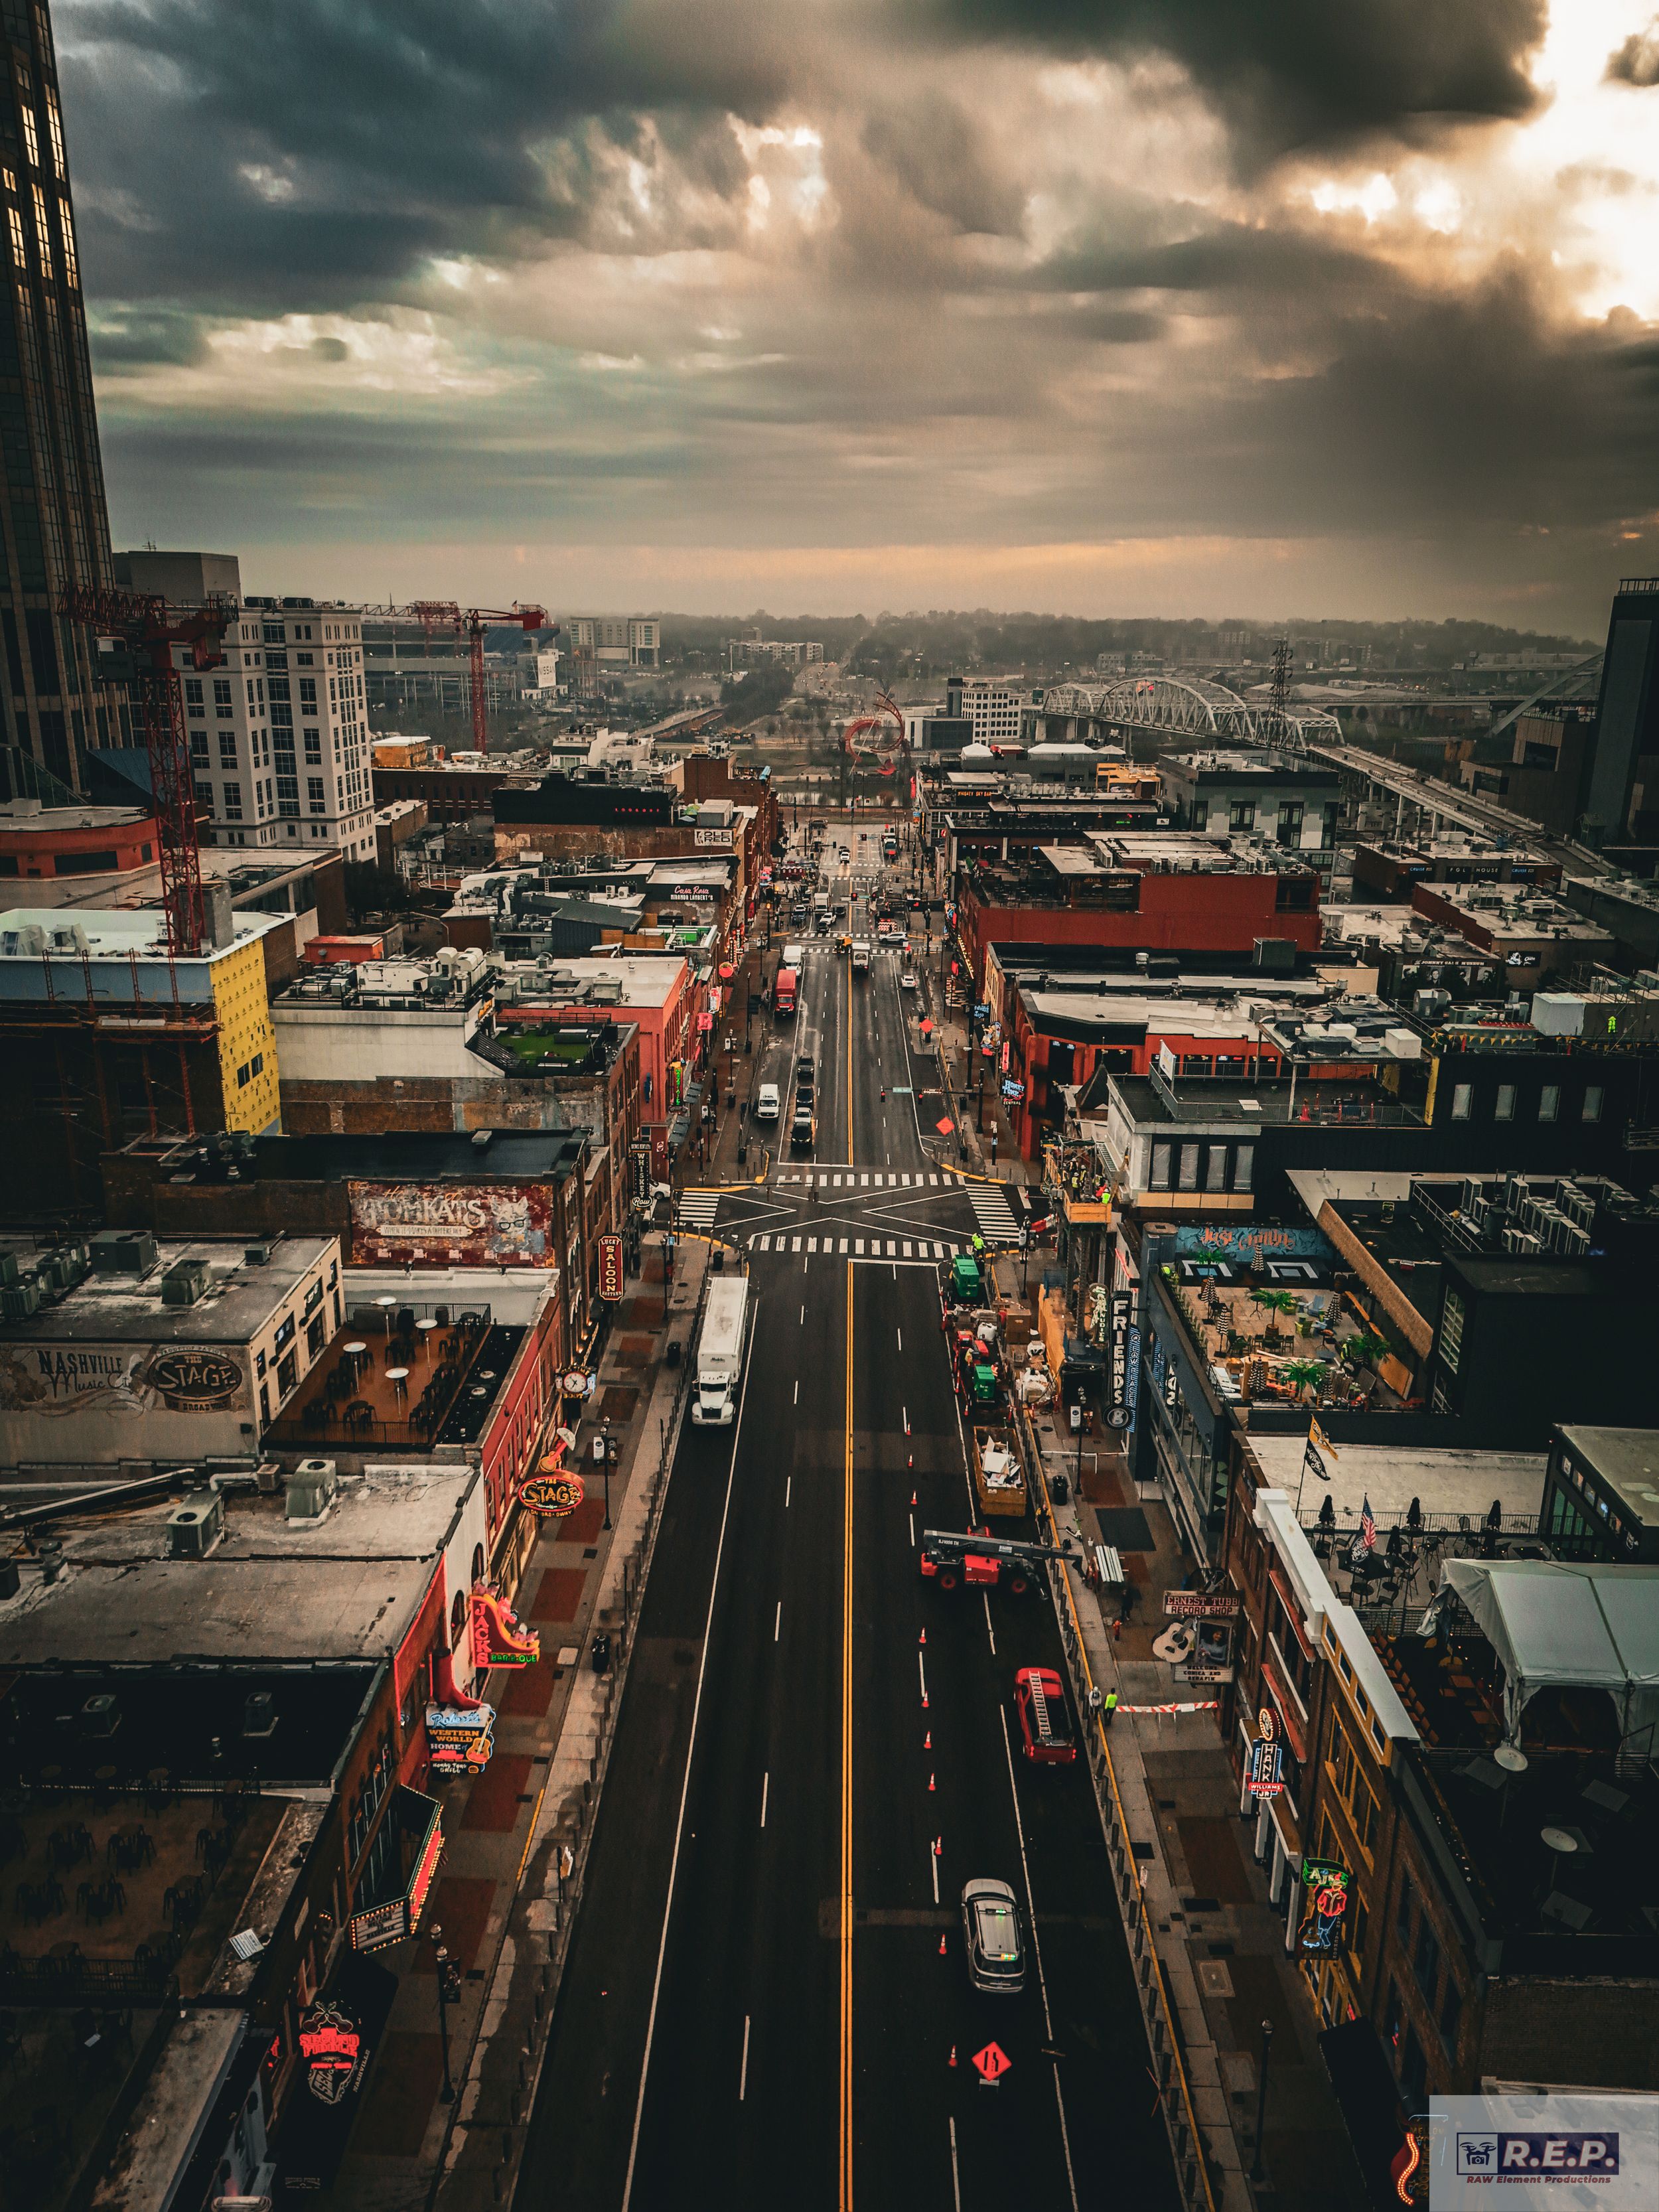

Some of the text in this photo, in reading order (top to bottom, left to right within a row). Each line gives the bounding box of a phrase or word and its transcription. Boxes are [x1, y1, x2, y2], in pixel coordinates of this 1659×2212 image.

[674, 885, 709, 894] Casa Rosa
[1002, 1085, 1019, 1096] TONK
[1005, 1079, 1025, 1092] HONKY
[637, 1153, 646, 1198] WHISKEY
[605, 1246, 616, 1291] SALOON
[36, 1350, 123, 1374] NASHVILLE
[1113, 1299, 1128, 1404] FRIENDS
[44, 1372, 106, 1398] Music
[155, 1359, 236, 1389] STAGE
[524, 1483, 581, 1505] STAGE
[1167, 1596, 1206, 1605] ERNEST
[1171, 1606, 1206, 1615] RECORD
[474, 1603, 492, 1664] JACKS
[430, 1712, 481, 1729] Robert's
[1262, 1745, 1273, 1782] HANK
[299, 2033, 360, 2046] SECOND
[303, 2045, 358, 2057] FIDDLE
[352, 2049, 371, 2093] NASHVILLE
